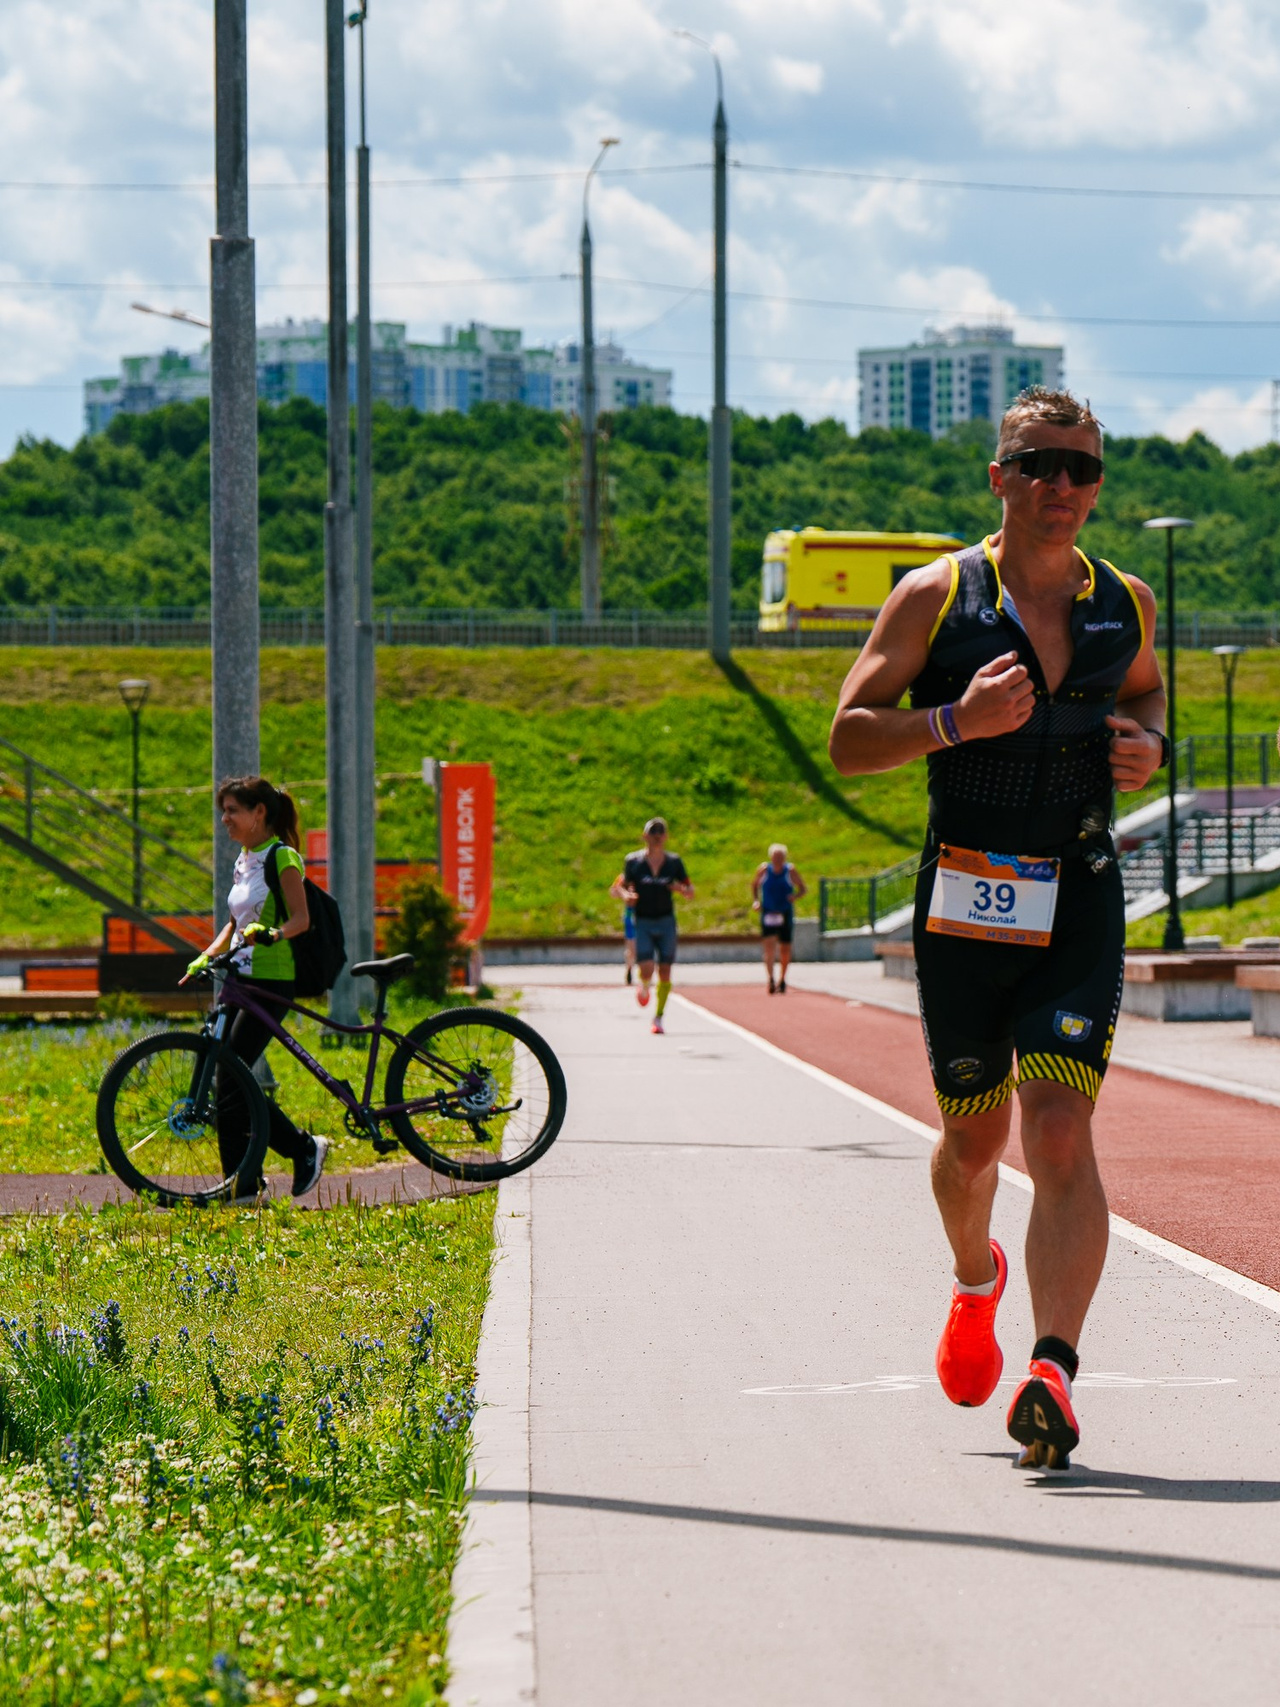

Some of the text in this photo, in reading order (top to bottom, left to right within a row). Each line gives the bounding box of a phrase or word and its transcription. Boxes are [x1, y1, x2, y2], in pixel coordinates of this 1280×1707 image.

[457, 787, 475, 843] ВОЛК
[457, 847, 475, 864] И
[973, 880, 1016, 914] 39
[967, 909, 1017, 925] Николай
